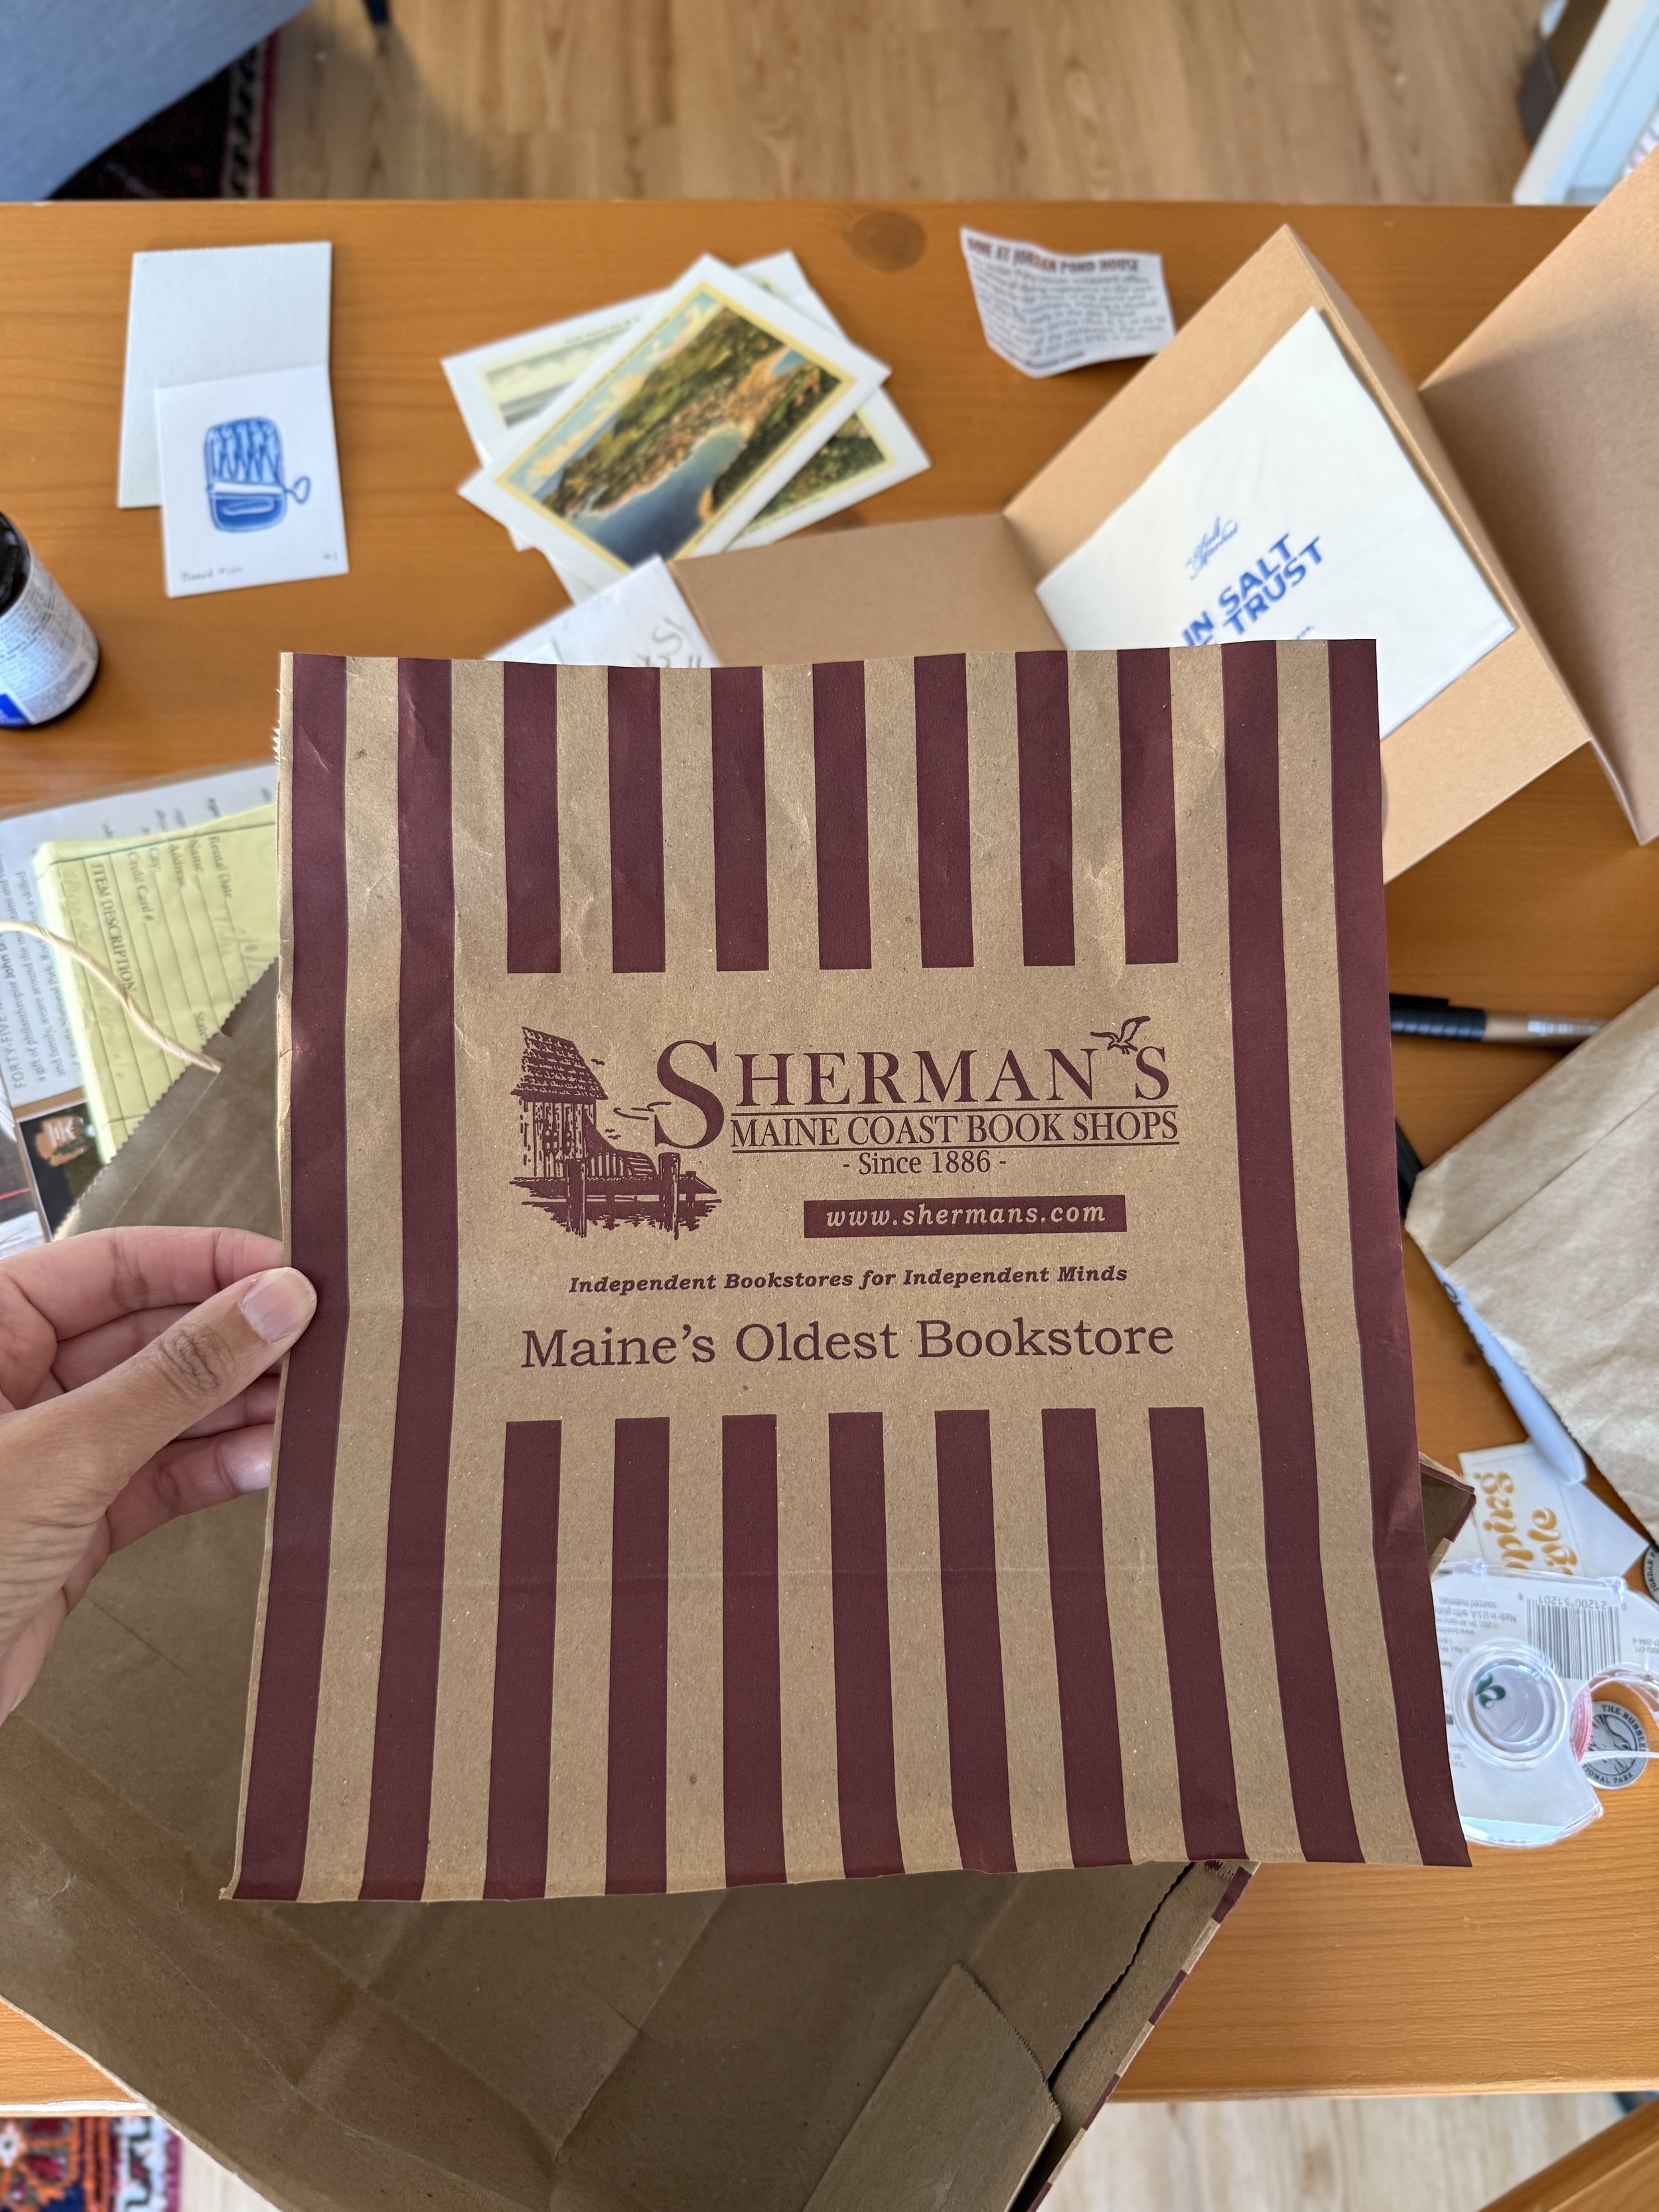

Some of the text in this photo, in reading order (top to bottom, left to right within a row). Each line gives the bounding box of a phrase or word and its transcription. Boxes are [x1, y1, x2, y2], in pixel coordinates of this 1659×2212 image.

[1182, 610, 1214, 646] IN
[1218, 533, 1291, 615] SALT
[1222, 536, 1323, 636] TRUST
[137, 885, 154, 913] Card
[92, 863, 111, 898] ITEM
[102, 899, 137, 993] DESCRIPTION
[731, 1110, 1178, 1147] MAINE COAST BOOK SHOPS
[859, 1152, 922, 1175] Since
[931, 1149, 991, 1173] 1886
[827, 1203, 1106, 1226] www.shermans.com
[569, 1265, 1127, 1295] Independent Bookstores for Independent Minds
[522, 1317, 1174, 1368] Maine's Oldest Bookstore
[1539, 1595, 1569, 1606] 51201
[1575, 1598, 1607, 1610] 21200
[1498, 1611, 1516, 1623] Made
[1601, 1704, 1621, 1714] THE
[1583, 1763, 1634, 1784] TIONAL PARK
